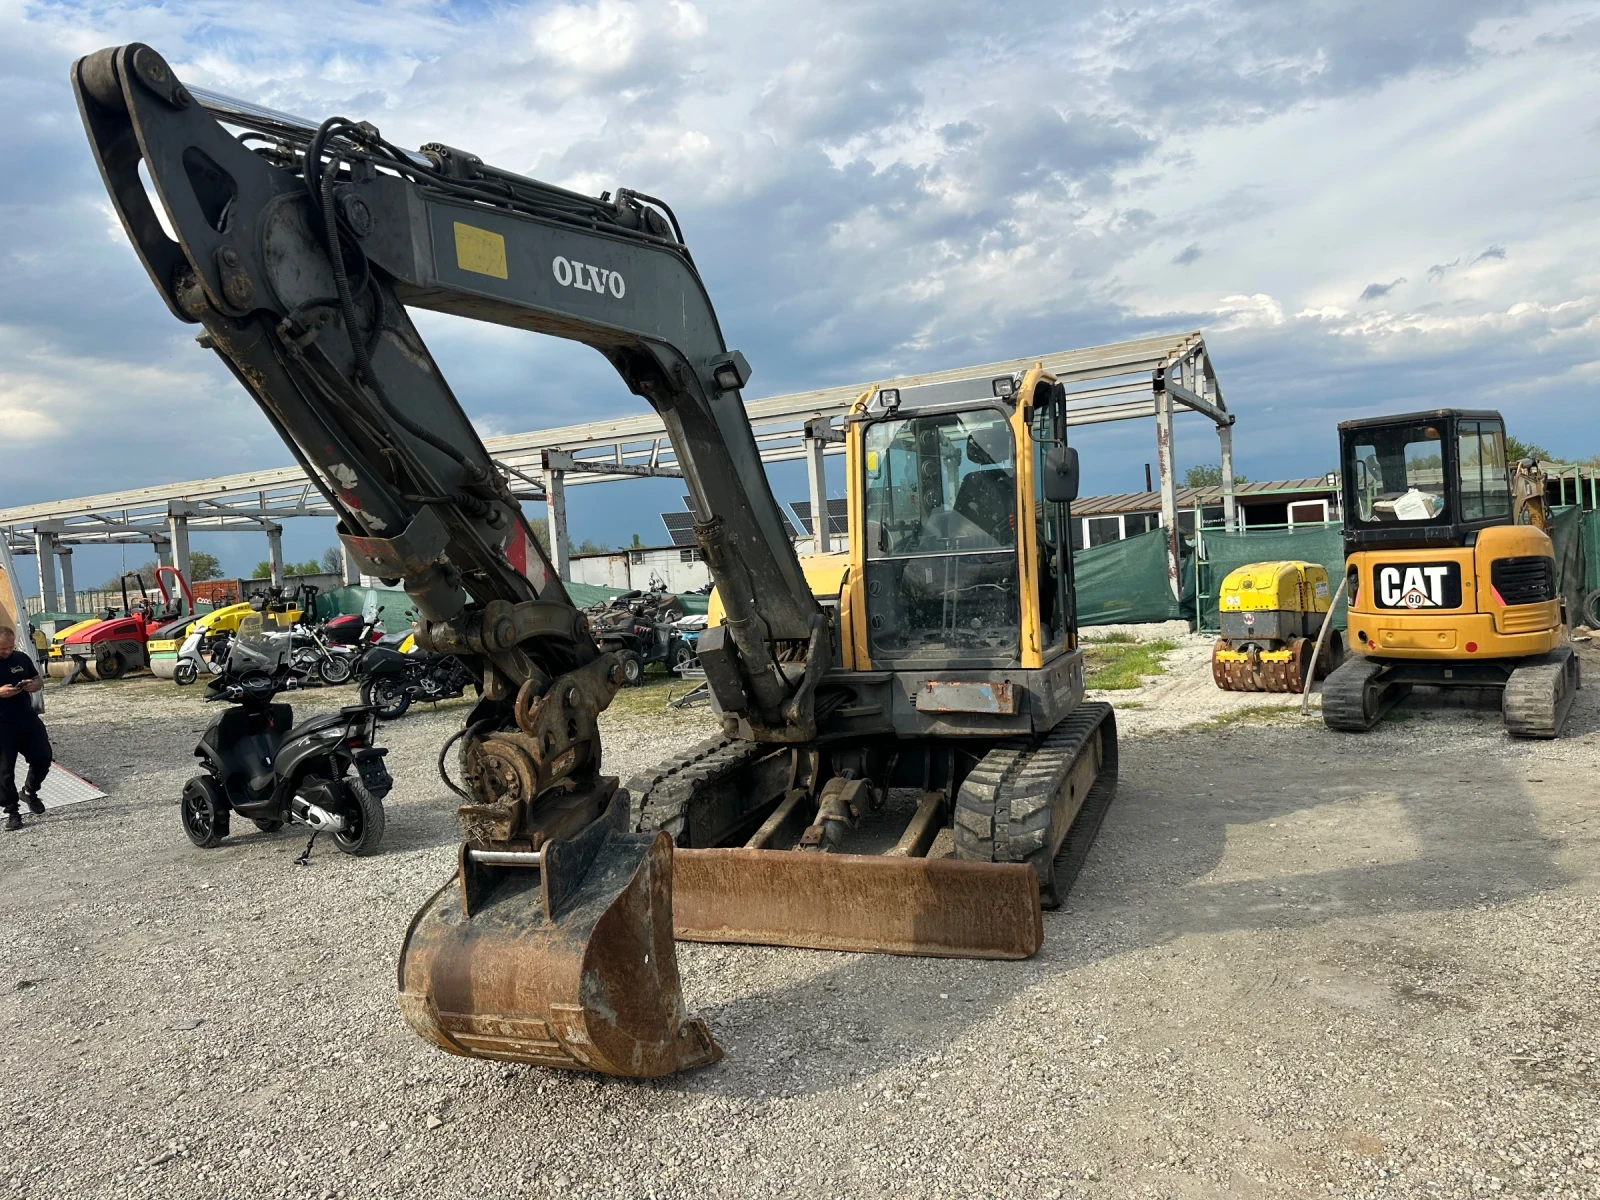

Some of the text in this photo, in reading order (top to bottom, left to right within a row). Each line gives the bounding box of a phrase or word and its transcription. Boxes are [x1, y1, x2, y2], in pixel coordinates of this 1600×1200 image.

[552, 255, 626, 299] OLVO
[1380, 566, 1448, 606] CAT
[1408, 594, 1421, 604] 60
